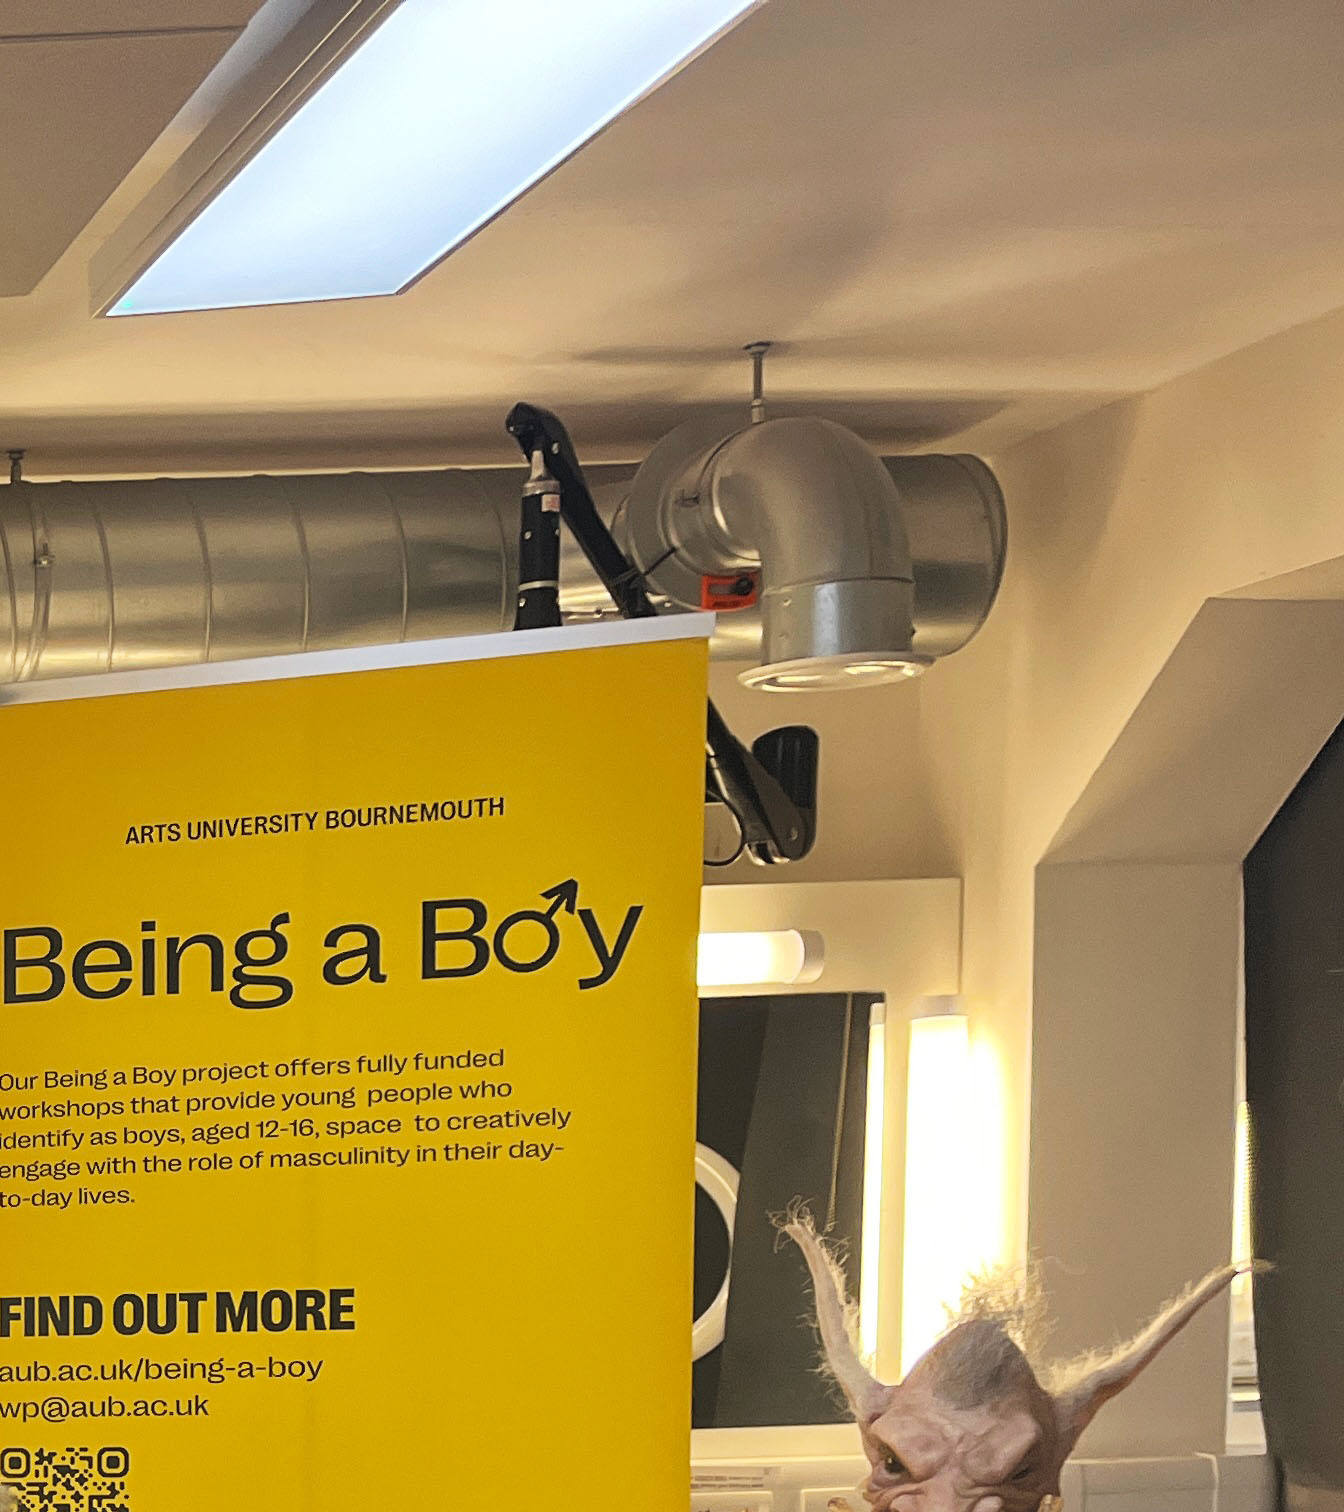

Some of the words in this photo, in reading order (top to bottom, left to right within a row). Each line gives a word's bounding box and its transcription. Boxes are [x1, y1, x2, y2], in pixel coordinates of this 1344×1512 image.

[125, 822, 181, 845] ARTS
[187, 810, 319, 841] UNIVERSITY
[325, 795, 505, 830] BOURNEMOUTH
[3, 911, 294, 1010] Being
[322, 923, 388, 986] a
[421, 878, 644, 990] Boy
[44, 1068, 108, 1091] Being
[113, 1070, 128, 1086] a
[133, 1065, 177, 1087] Boy
[182, 1060, 269, 1086] project
[275, 1057, 351, 1077] offers
[356, 1053, 408, 1076] fully
[413, 1047, 504, 1071] funded
[130, 1094, 180, 1115] that
[186, 1090, 275, 1116] provide
[281, 1086, 356, 1112] young
[367, 1082, 453, 1107] people
[459, 1079, 512, 1099] who
[90, 1130, 117, 1146] as
[123, 1126, 185, 1147] boys,
[191, 1120, 250, 1145] aged
[256, 1117, 320, 1139] 12-16,
[326, 1118, 402, 1139] space
[414, 1114, 440, 1132] to
[447, 1106, 571, 1131] creatively
[86, 1155, 136, 1175] with
[142, 1154, 182, 1173] the
[188, 1152, 233, 1171] role
[239, 1149, 264, 1169] of
[270, 1146, 410, 1168] masculinity
[416, 1144, 437, 1162] in
[443, 1142, 502, 1161] their
[508, 1139, 563, 1162] day-
[78, 1186, 135, 1205] lives.
[0, 1295, 103, 1338] FIND
[112, 1291, 208, 1336] OUT
[215, 1288, 356, 1333] MORE
